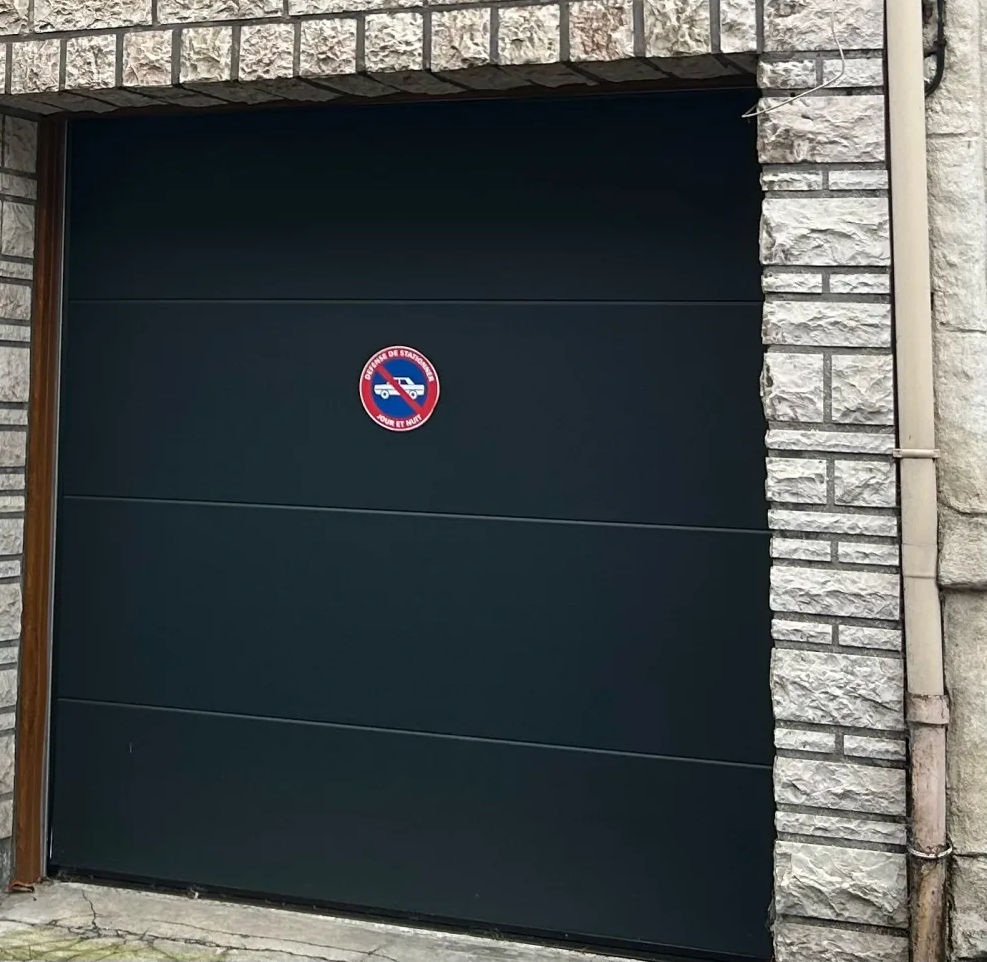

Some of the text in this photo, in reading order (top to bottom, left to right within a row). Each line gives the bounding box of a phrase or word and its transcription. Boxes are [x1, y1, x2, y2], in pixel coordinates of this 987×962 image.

[388, 349, 399, 358] DE
[400, 349, 435, 383] STATIONNER
[376, 413, 422, 428] JOUR ET NUIT
